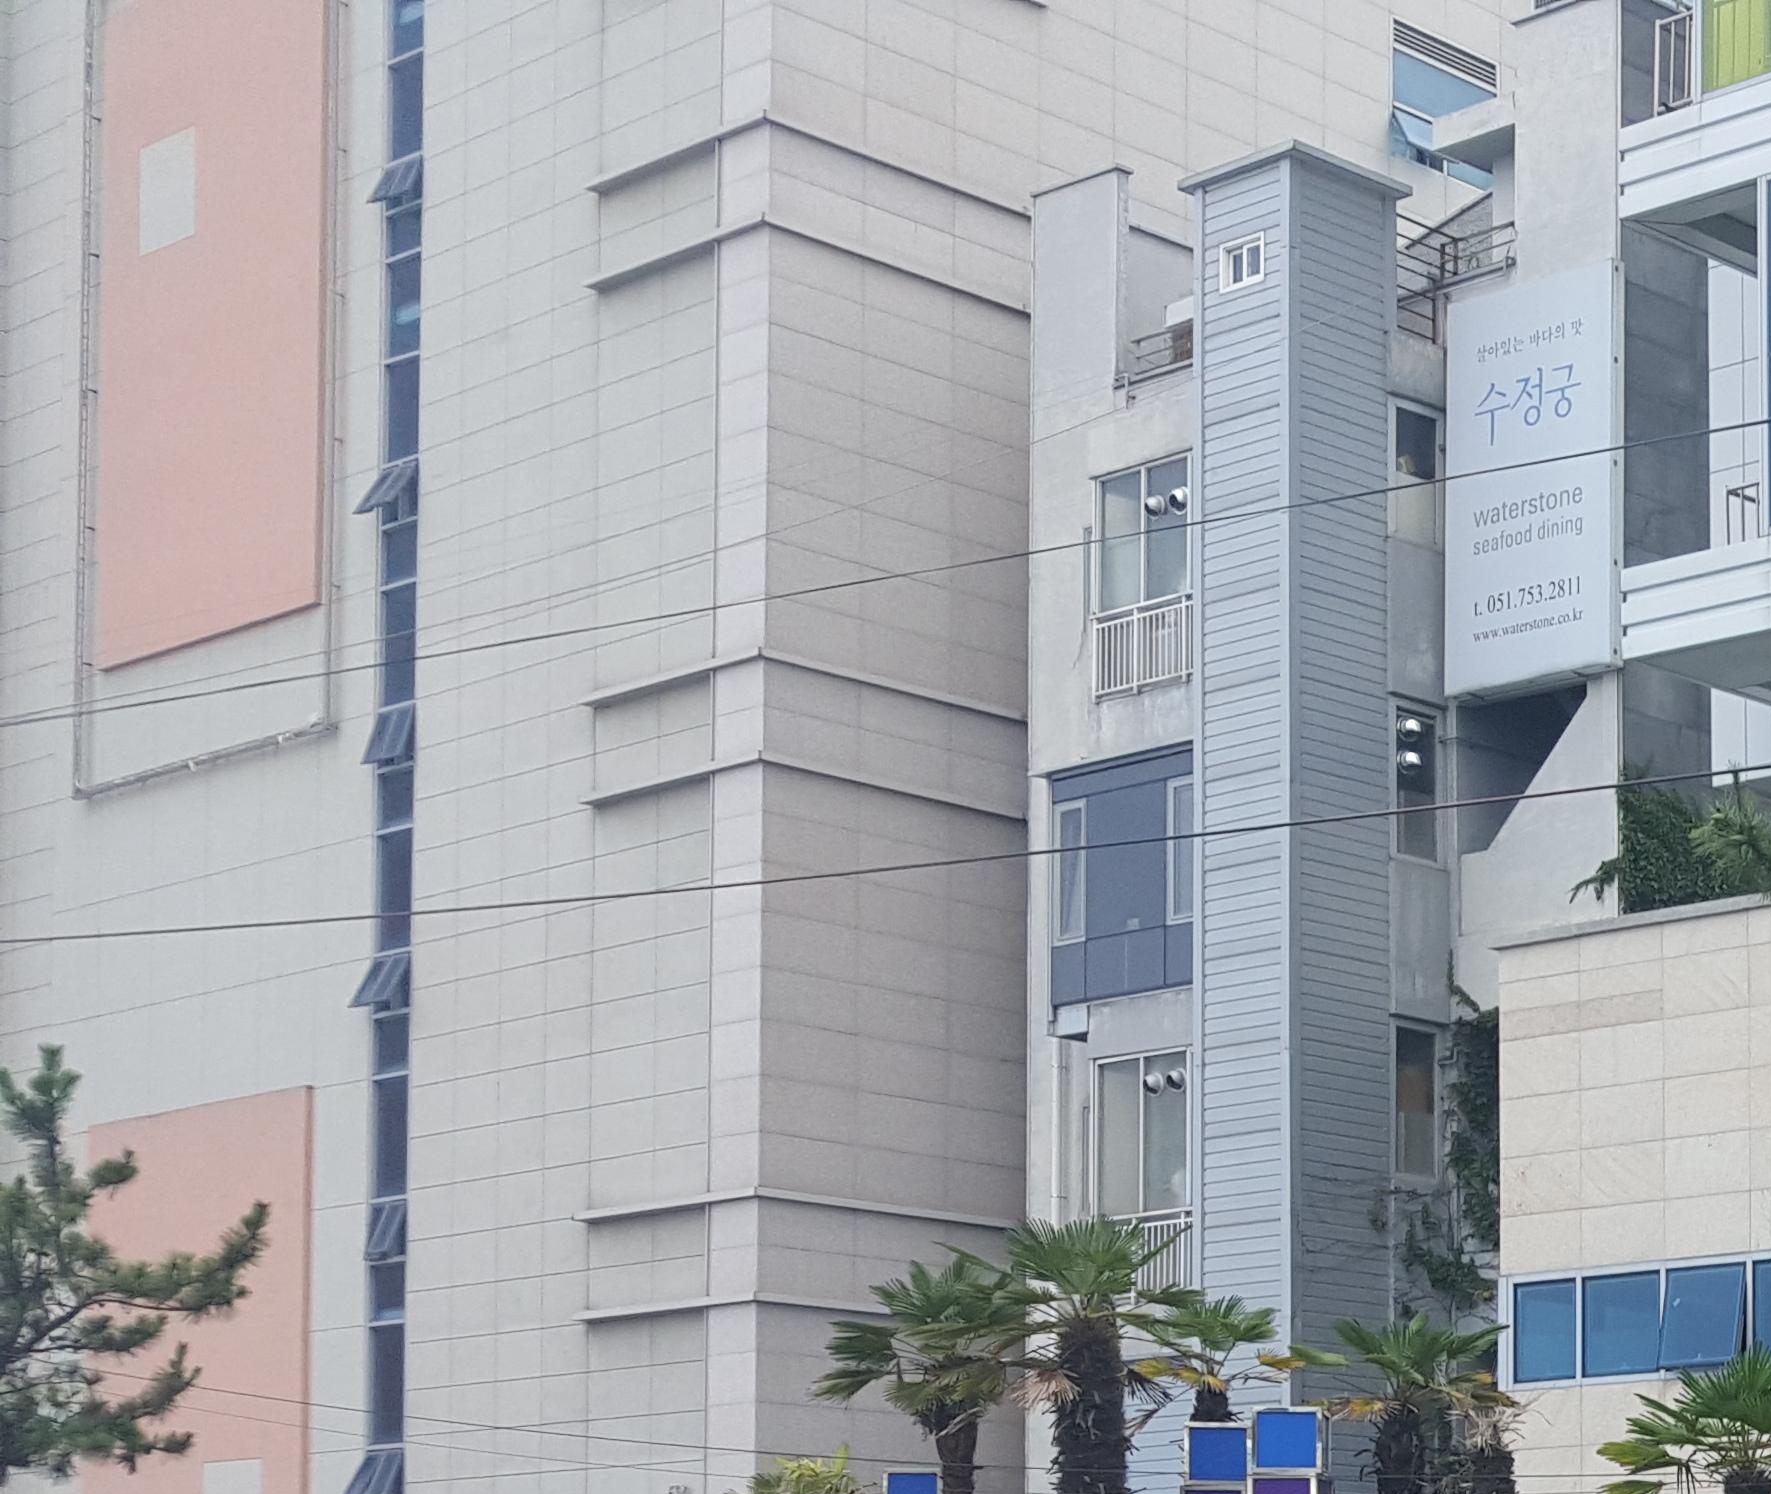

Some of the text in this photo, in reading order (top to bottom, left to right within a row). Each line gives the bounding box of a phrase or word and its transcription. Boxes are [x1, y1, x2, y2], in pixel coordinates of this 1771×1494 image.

[1476, 317, 1584, 363] 살아있는 바다의 맛
[1474, 363, 1582, 447] 수정궁
[1473, 485, 1584, 529] waterstone
[1473, 515, 1584, 556] seafood dining
[1473, 575, 1581, 617] t. 051.753.2811
[1472, 607, 1584, 643] www.waterstone.co.kr
